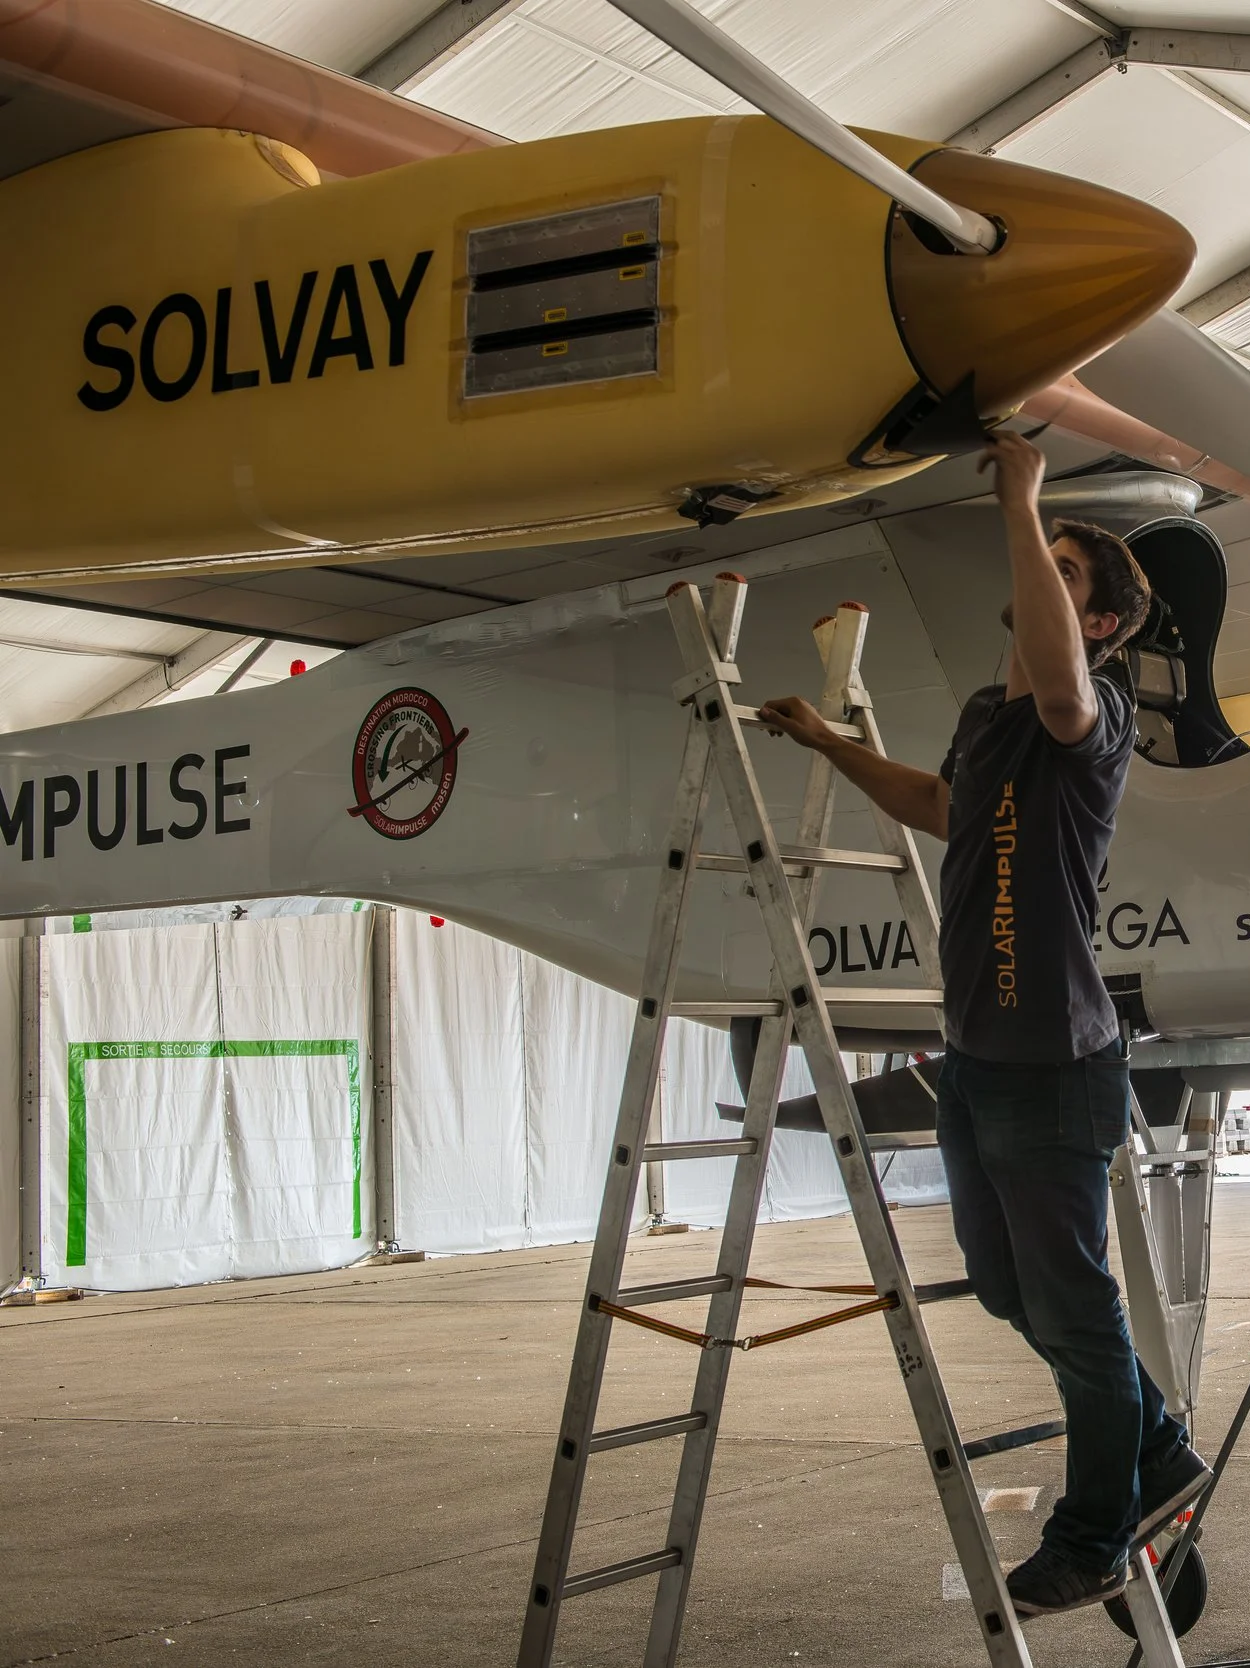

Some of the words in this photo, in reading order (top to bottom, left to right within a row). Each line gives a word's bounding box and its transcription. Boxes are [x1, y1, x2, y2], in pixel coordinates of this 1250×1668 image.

[76, 250, 433, 412] SOLVAY
[357, 699, 392, 756] DESTINATION
[392, 693, 428, 707] MOROCCO
[367, 720, 390, 778] CROSSING
[389, 711, 435, 735] FRONTIERS
[0, 744, 251, 862] MPULSE
[432, 772, 452, 815] masen
[374, 815, 428, 835] SOLARIMPULSE
[807, 919, 921, 976] OLVA
[101, 1044, 143, 1057] SORTIE
[160, 1043, 211, 1056] SECOURS
